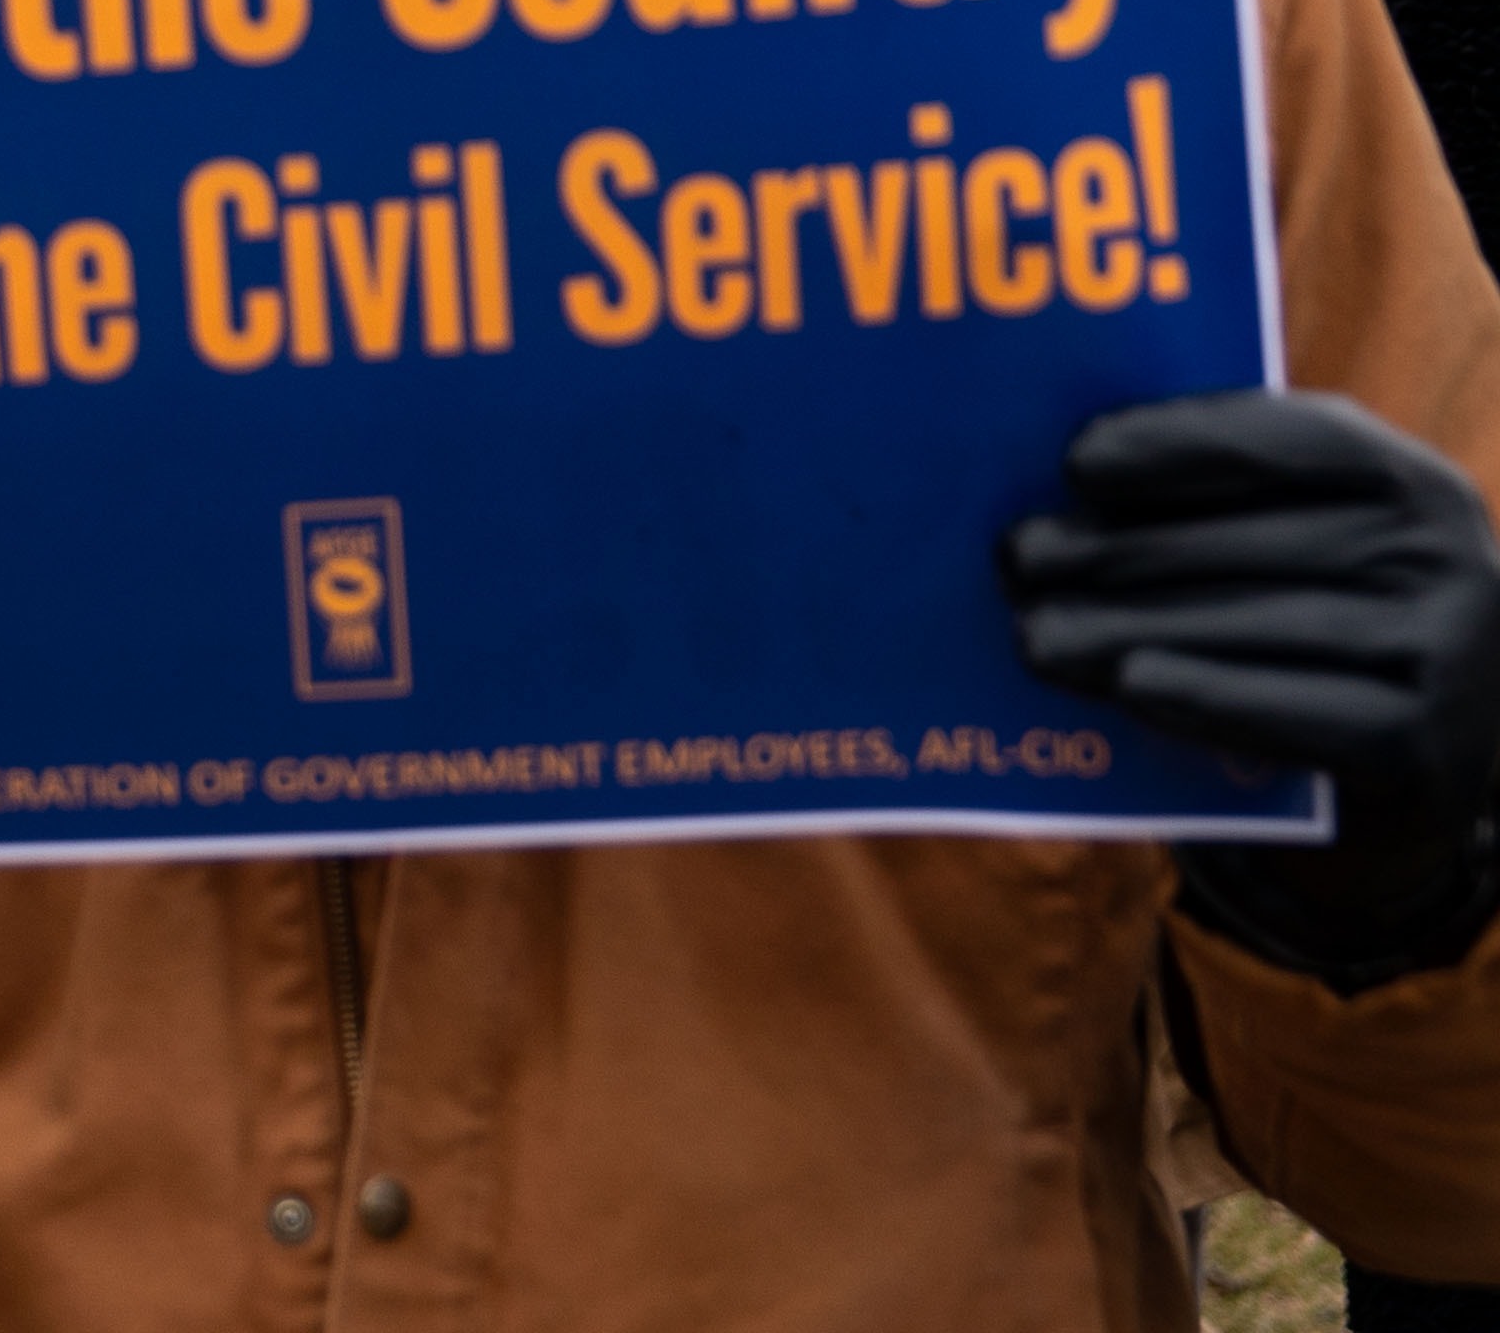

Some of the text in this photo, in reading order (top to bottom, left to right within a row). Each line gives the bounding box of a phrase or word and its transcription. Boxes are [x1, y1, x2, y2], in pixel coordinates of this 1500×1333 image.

[184, 144, 509, 368] Civil
[562, 78, 1186, 341] Service!
[187, 757, 257, 807] OF
[261, 739, 606, 804] GOVERNMENT
[614, 725, 911, 788] EMPLOYEES,
[917, 724, 1114, 779] AFL-CIO
